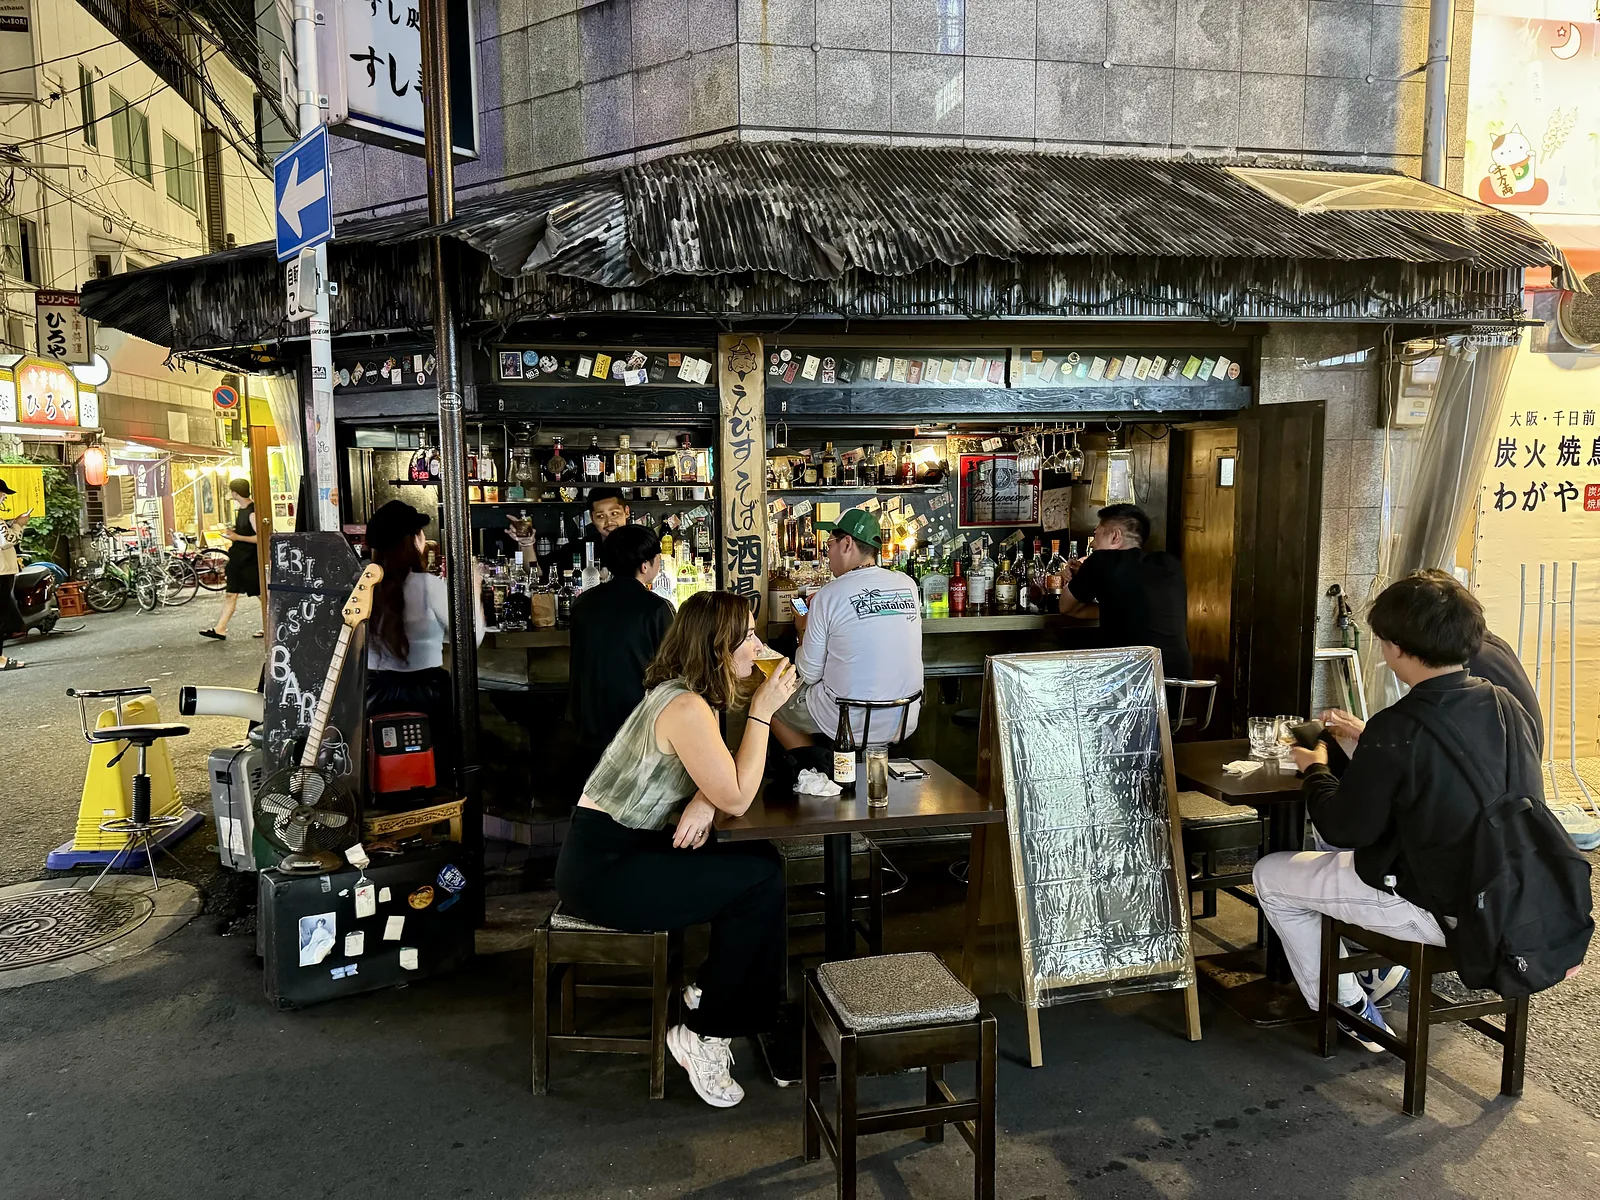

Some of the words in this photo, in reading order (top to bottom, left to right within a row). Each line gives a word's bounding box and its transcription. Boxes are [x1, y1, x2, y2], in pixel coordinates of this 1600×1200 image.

[45, 312, 67, 359] ひろや
[27, 394, 72, 419] ひろや
[1510, 410, 1596, 428] 大阪・千日前
[971, 488, 1030, 503] Budweiser
[1494, 481, 1579, 512] わがや
